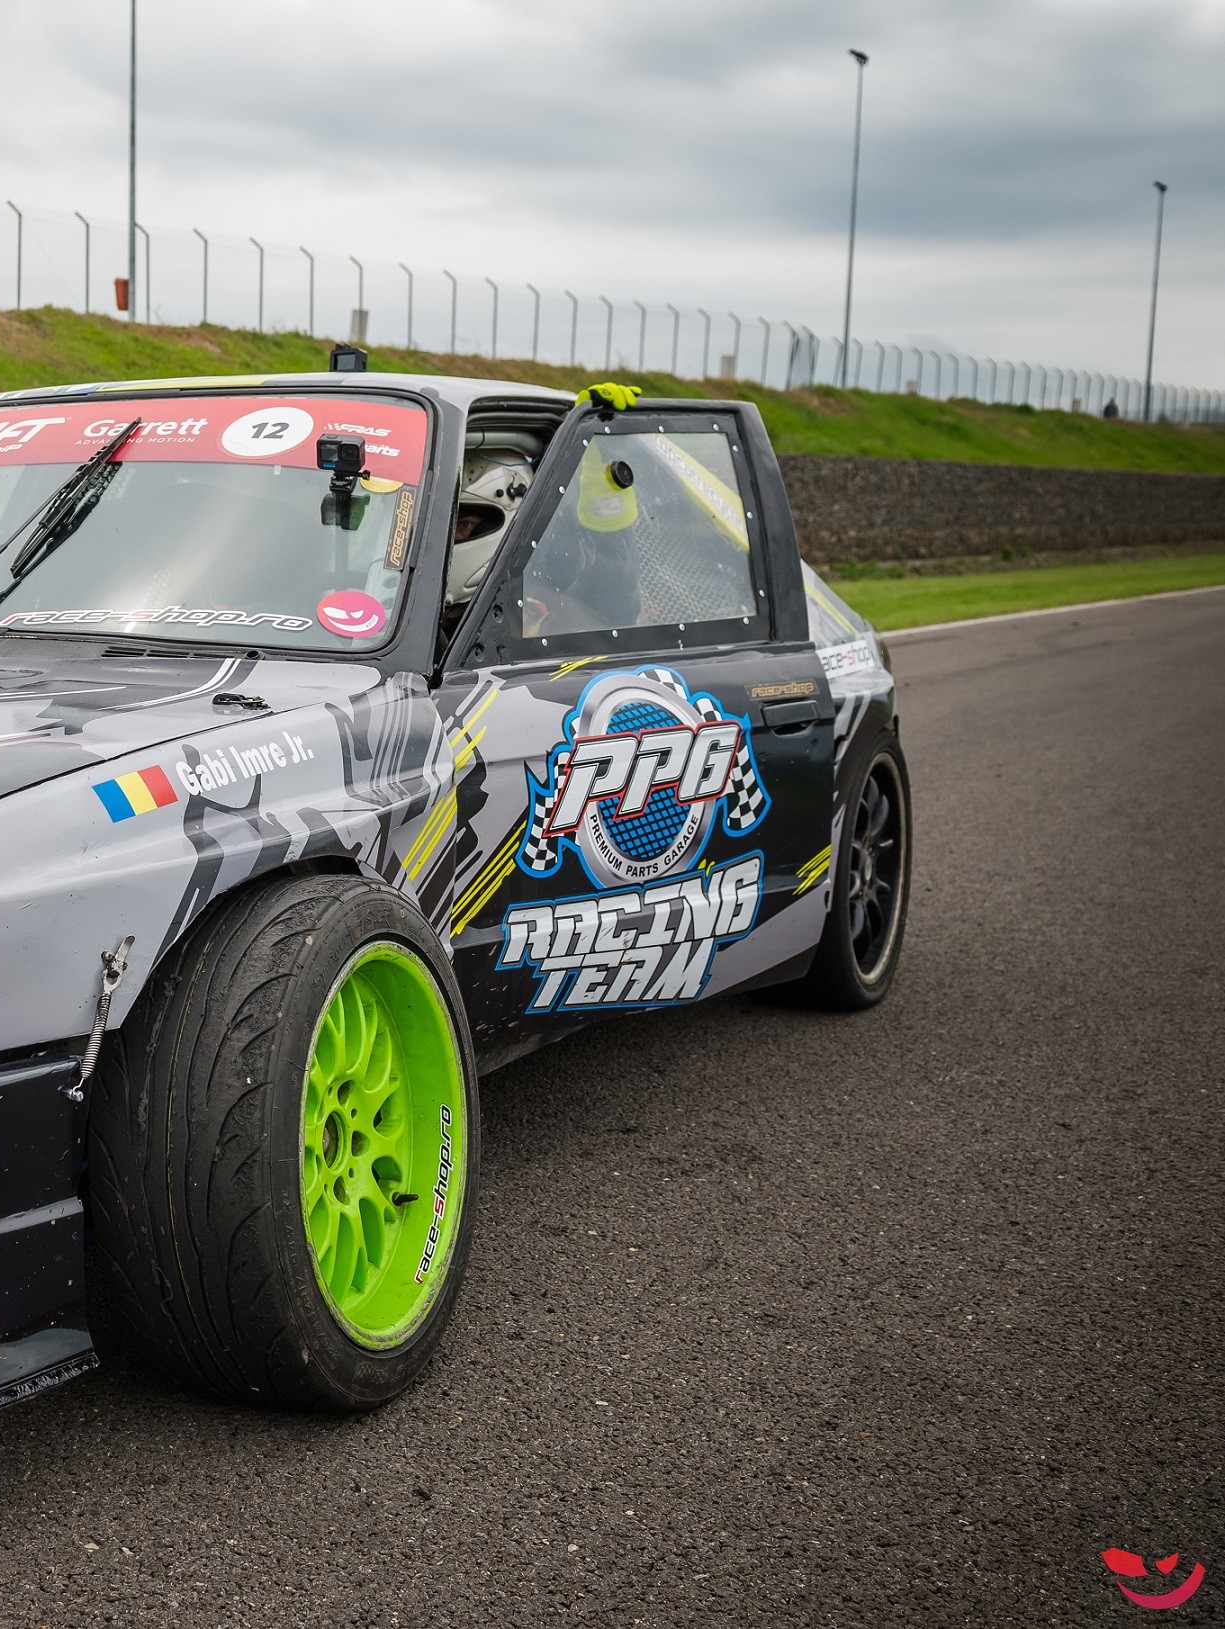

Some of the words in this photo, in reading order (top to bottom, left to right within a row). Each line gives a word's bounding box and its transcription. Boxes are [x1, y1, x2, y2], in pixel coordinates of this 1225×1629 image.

[251, 422, 289, 439] 12
[821, 646, 872, 671] ace-shop
[176, 749, 235, 796] Gabi
[229, 739, 286, 779] Imre
[282, 731, 314, 764] Jr.
[546, 723, 741, 832] PPG
[590, 813, 622, 872] PREMIUM
[625, 862, 659, 877] PARTS
[664, 814, 699, 866] GARAGE
[502, 857, 761, 964] RACING
[533, 937, 714, 1008] TEAM
[414, 1104, 454, 1285] race-shop.ro
